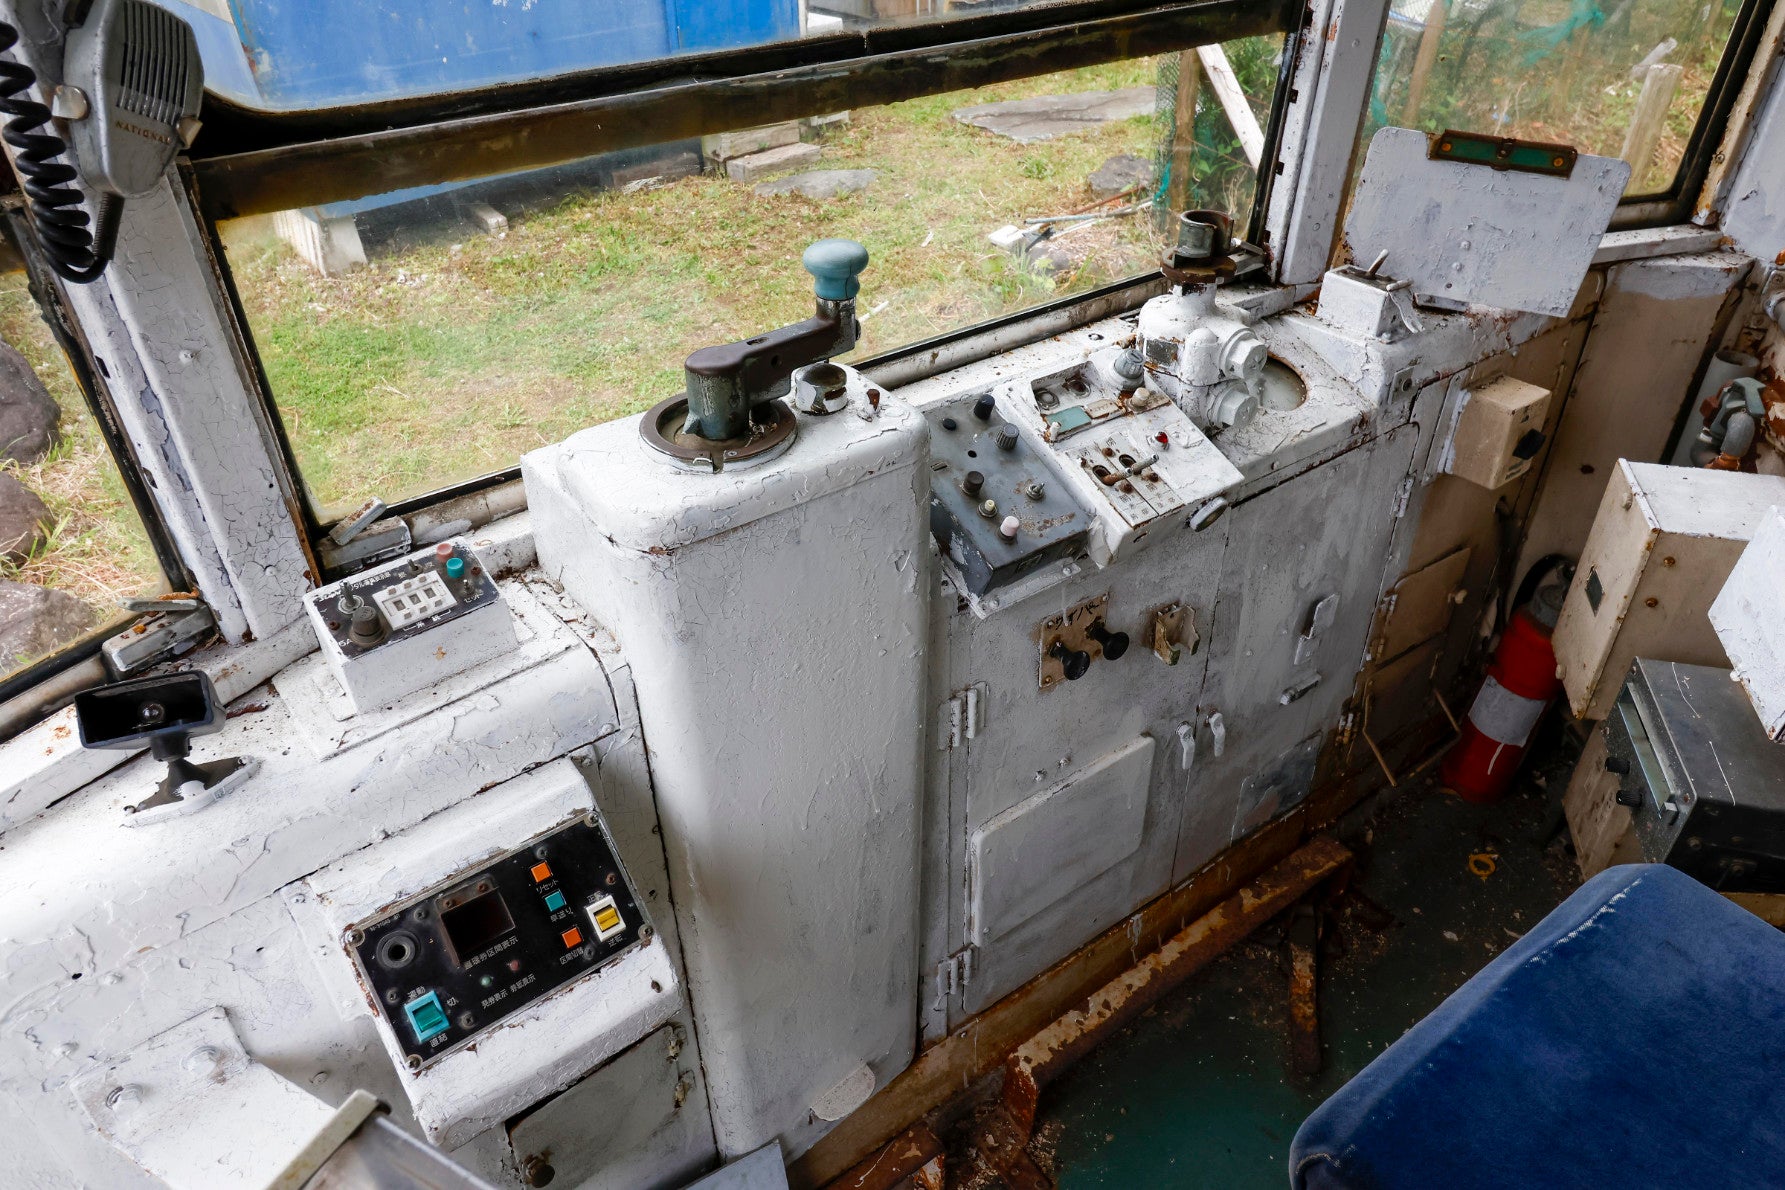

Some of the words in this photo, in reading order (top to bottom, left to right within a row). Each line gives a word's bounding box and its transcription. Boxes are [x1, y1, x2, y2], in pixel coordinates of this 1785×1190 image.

[115, 120, 171, 145] NATIONAL
[536, 879, 559, 894] リセット
